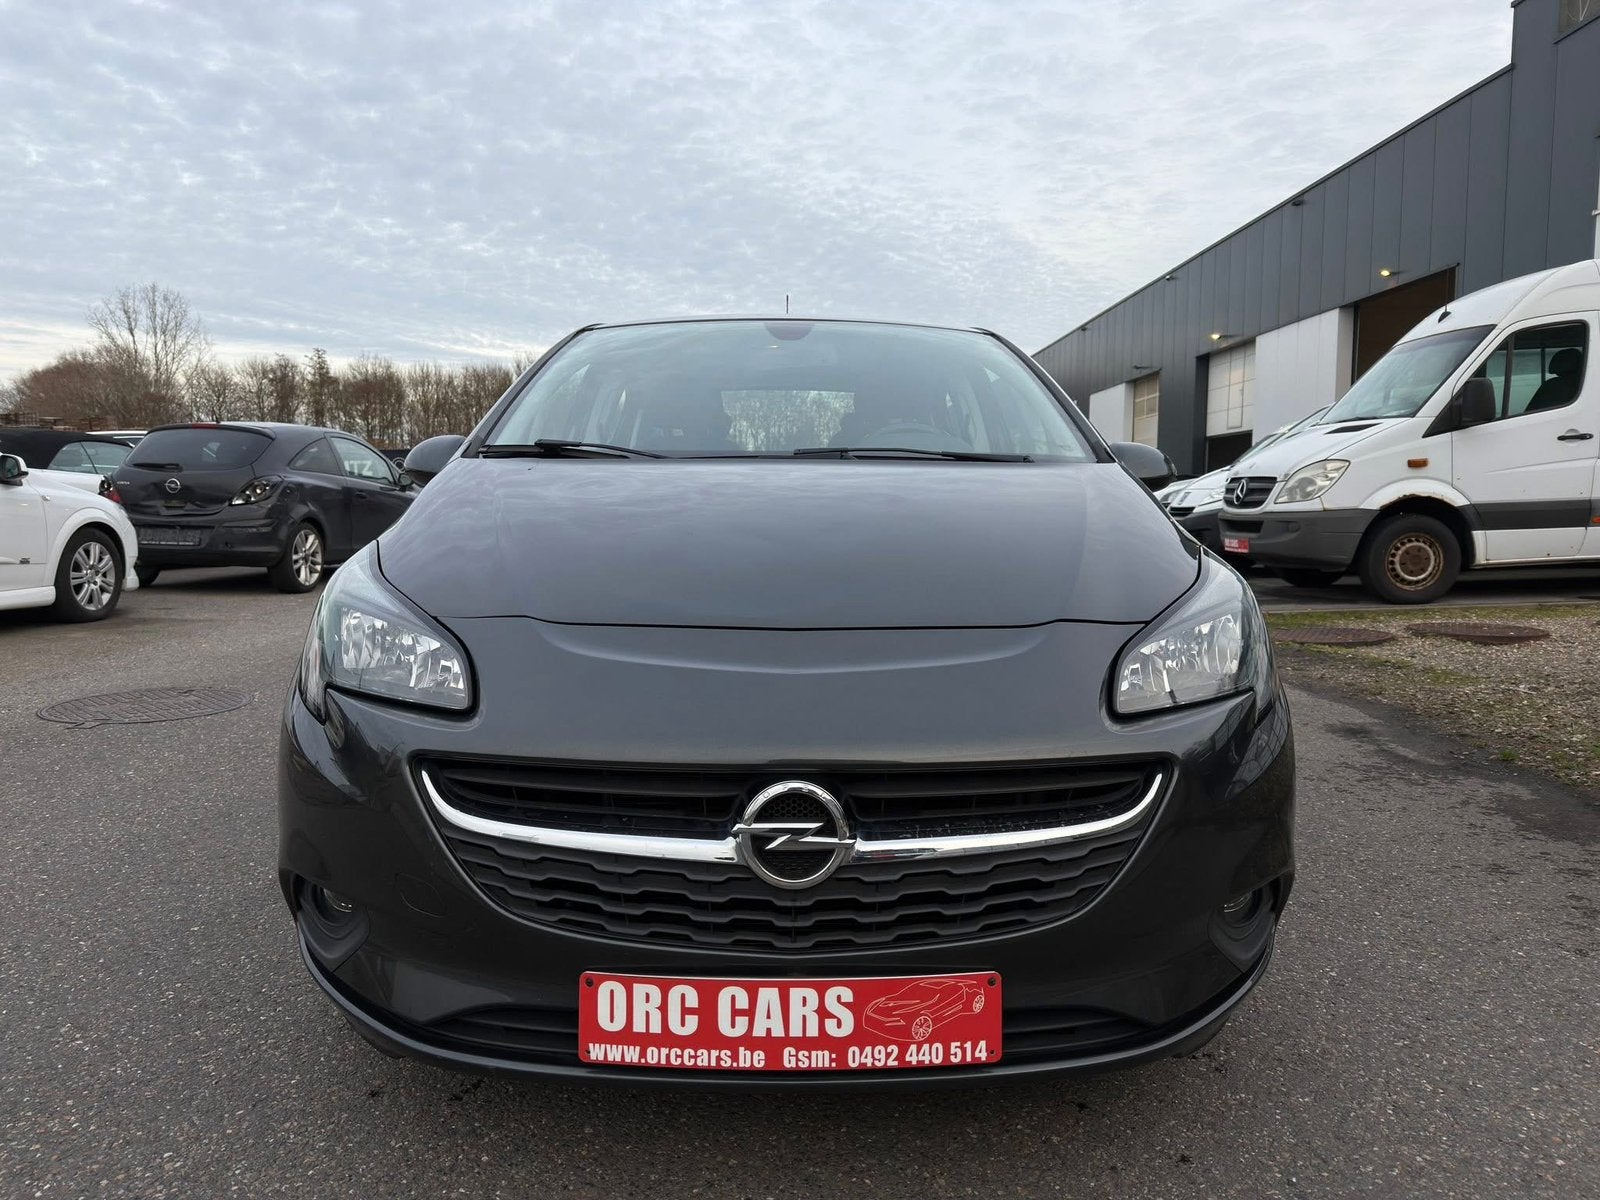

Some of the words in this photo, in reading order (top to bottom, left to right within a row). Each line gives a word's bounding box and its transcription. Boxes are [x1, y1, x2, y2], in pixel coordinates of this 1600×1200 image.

[597, 980, 699, 1036] ORC
[717, 985, 855, 1038] CARS
[589, 1042, 766, 1069] www.orccars.be
[783, 1046, 837, 1069] Gsm:
[847, 1044, 899, 1068] 0492
[905, 1042, 944, 1065] 440
[949, 1040, 988, 1063] 514
